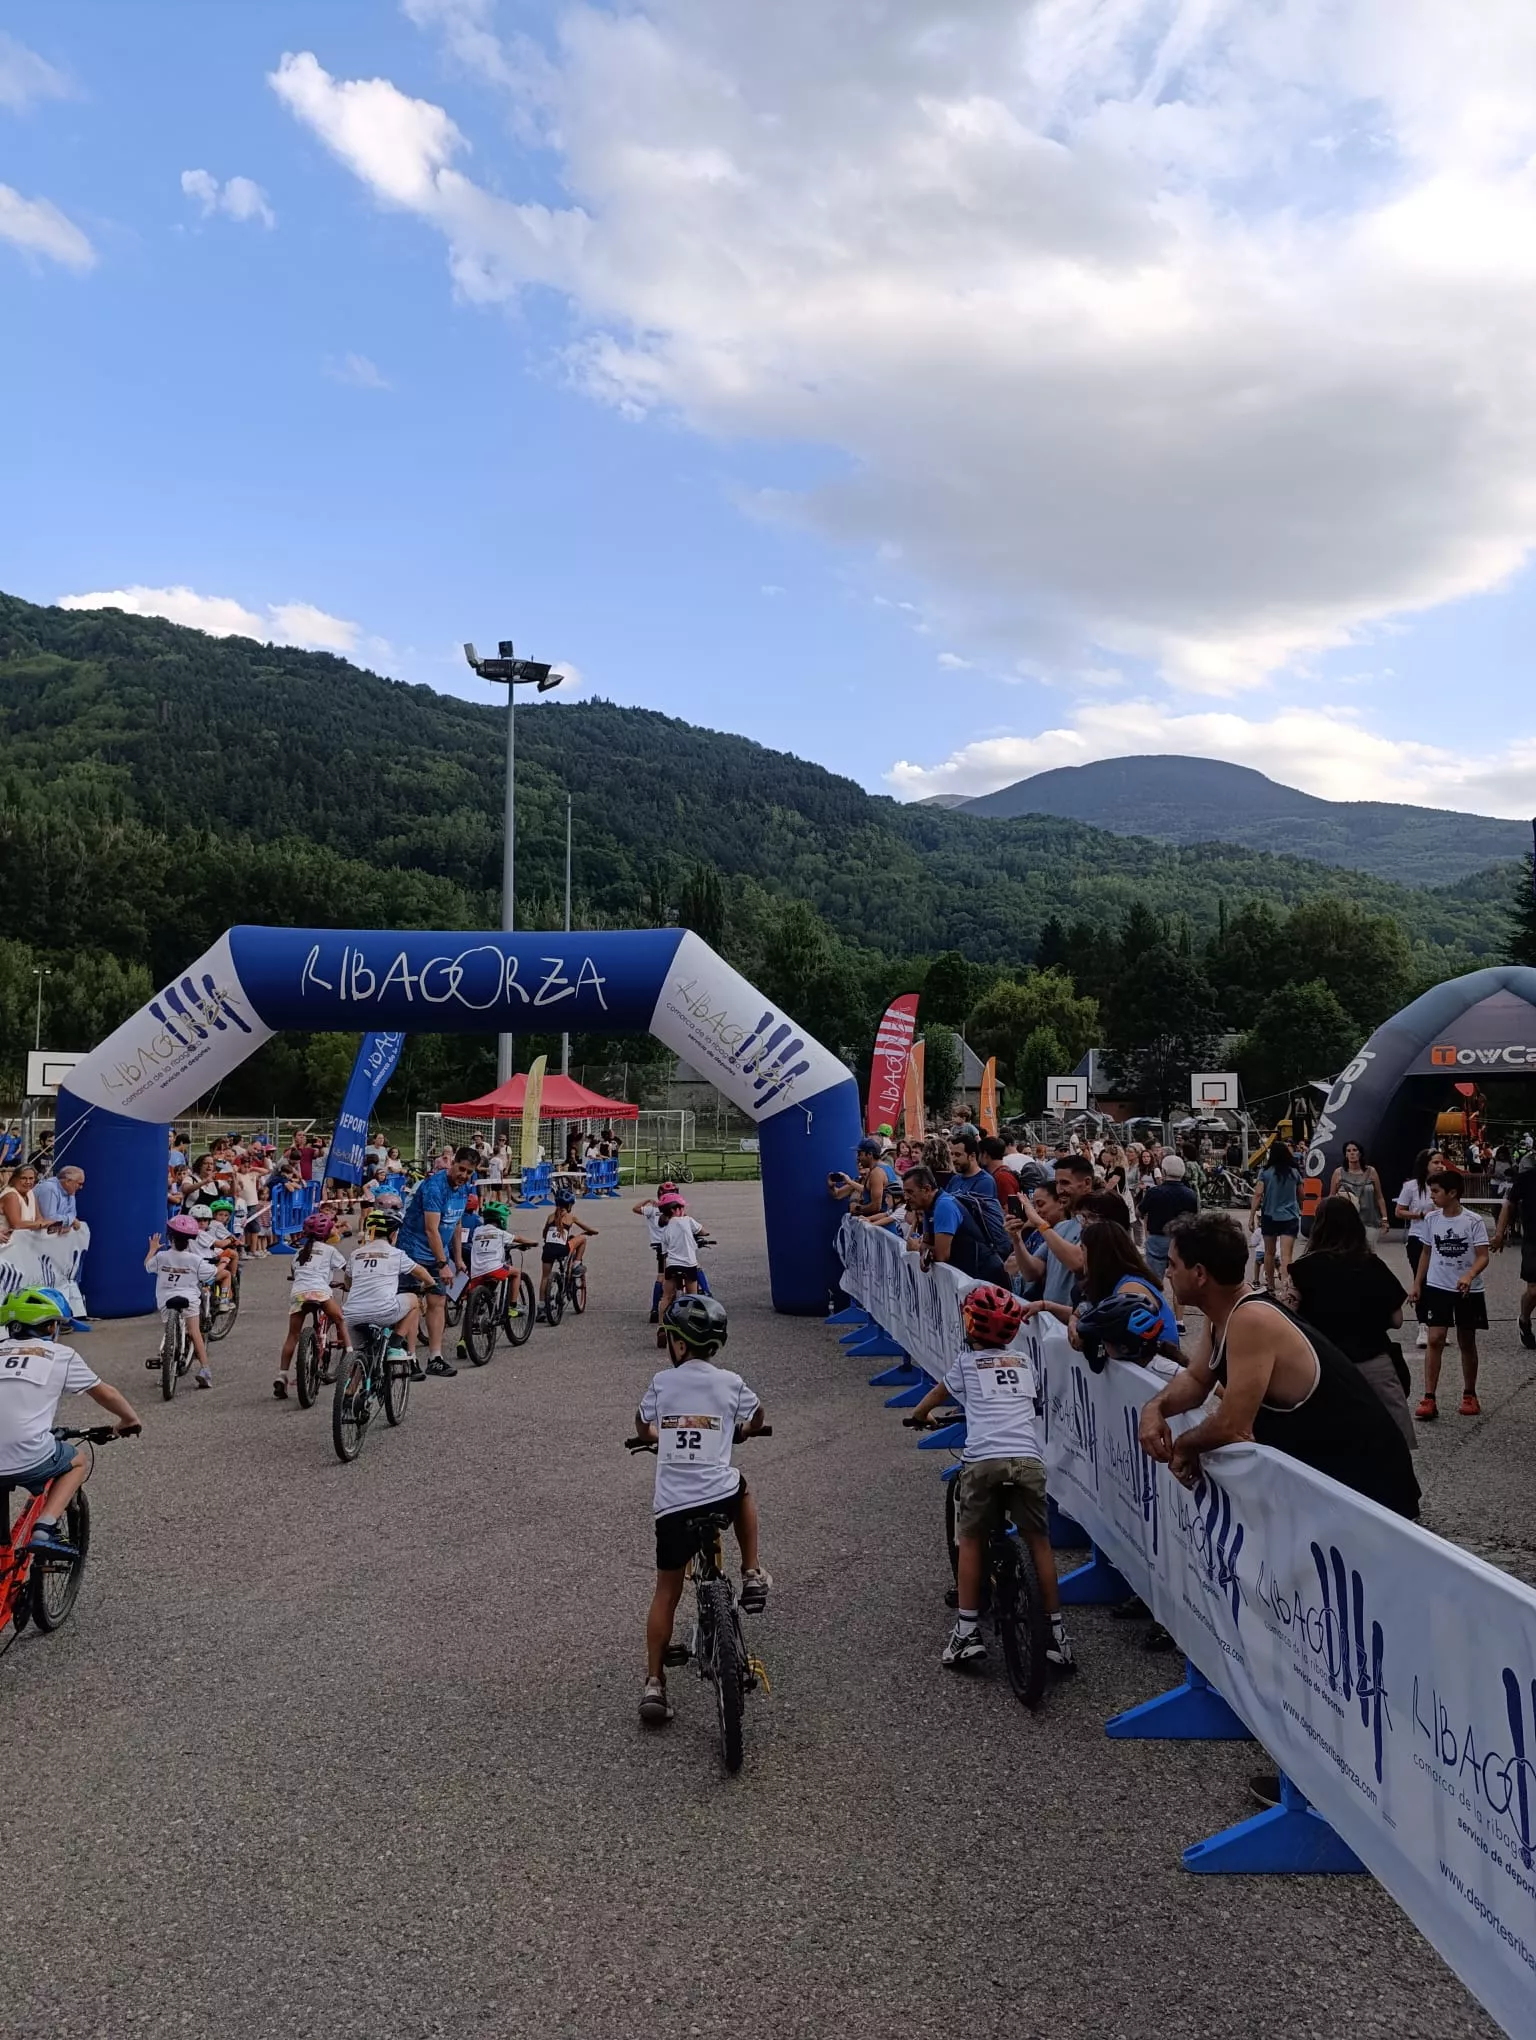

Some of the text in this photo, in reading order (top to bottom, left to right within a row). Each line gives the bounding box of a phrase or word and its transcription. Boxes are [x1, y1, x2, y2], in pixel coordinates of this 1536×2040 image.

[302, 943, 609, 1010] RIBAGORZA
[666, 1001, 696, 1030] comarca
[695, 1026, 705, 1039] de
[704, 1034, 712, 1046] la
[122, 1078, 154, 1106] comarca
[152, 1071, 164, 1082] de
[163, 1063, 172, 1074] la
[480, 1240, 490, 1248] 77
[363, 1259, 378, 1269] 70
[168, 1274, 181, 1282] 27
[5, 1356, 30, 1369] 61
[995, 1369, 1019, 1385] 29
[676, 1430, 702, 1450] 32
[1293, 1663, 1312, 1687] servicio
[1314, 1681, 1321, 1695] de
[1413, 1753, 1455, 1796] comarca
[1459, 1788, 1471, 1812] de
[1474, 1798, 1482, 1825] la
[1457, 1817, 1489, 1855] servicio
[1490, 1849, 1503, 1867] de
